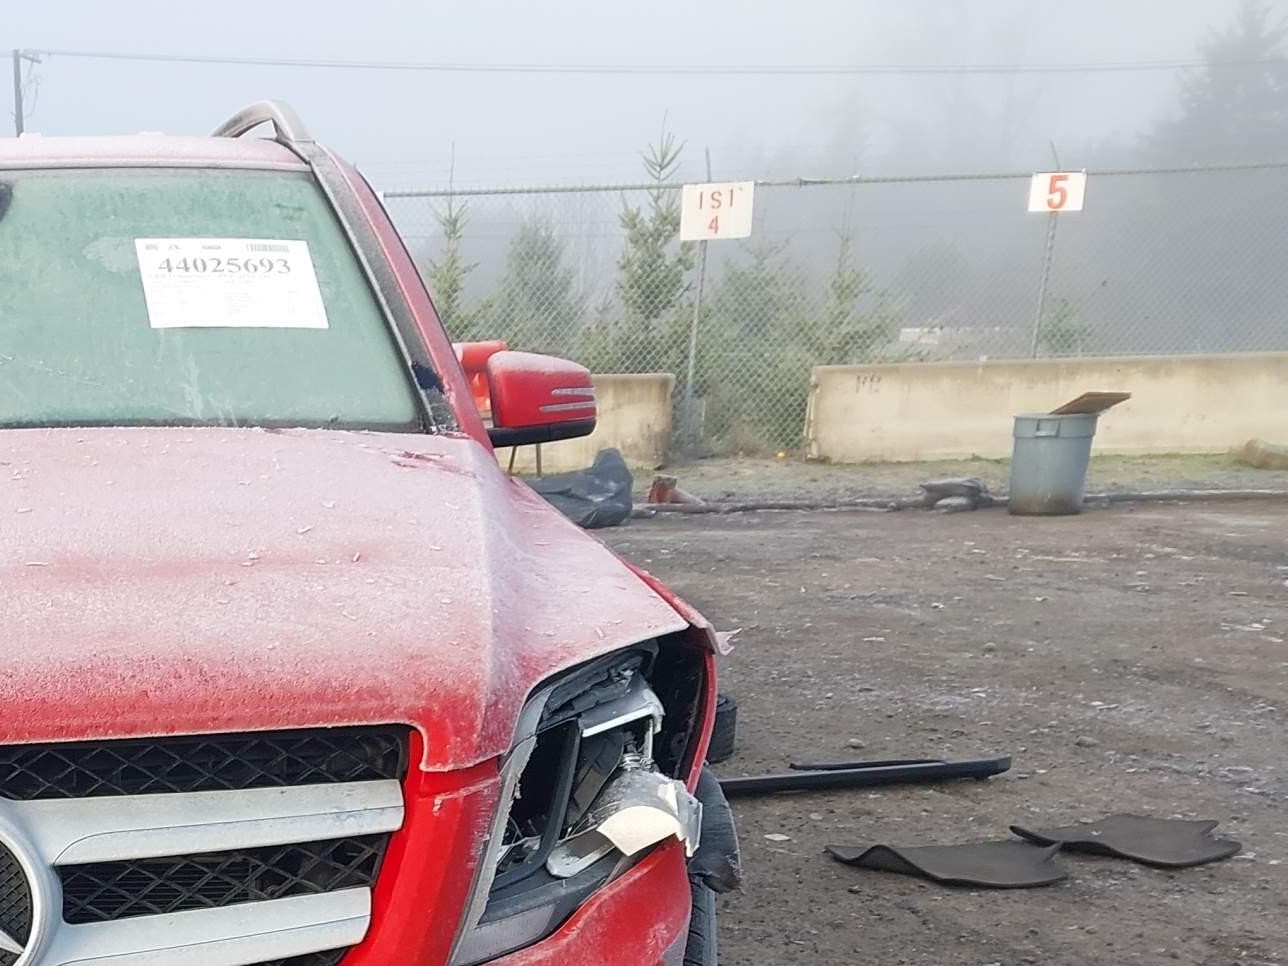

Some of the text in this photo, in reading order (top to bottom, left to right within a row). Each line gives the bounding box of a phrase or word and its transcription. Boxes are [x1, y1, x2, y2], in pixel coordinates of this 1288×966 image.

[1047, 175, 1069, 209] 5
[708, 215, 719, 234] 4
[158, 257, 291, 274] 44025693
